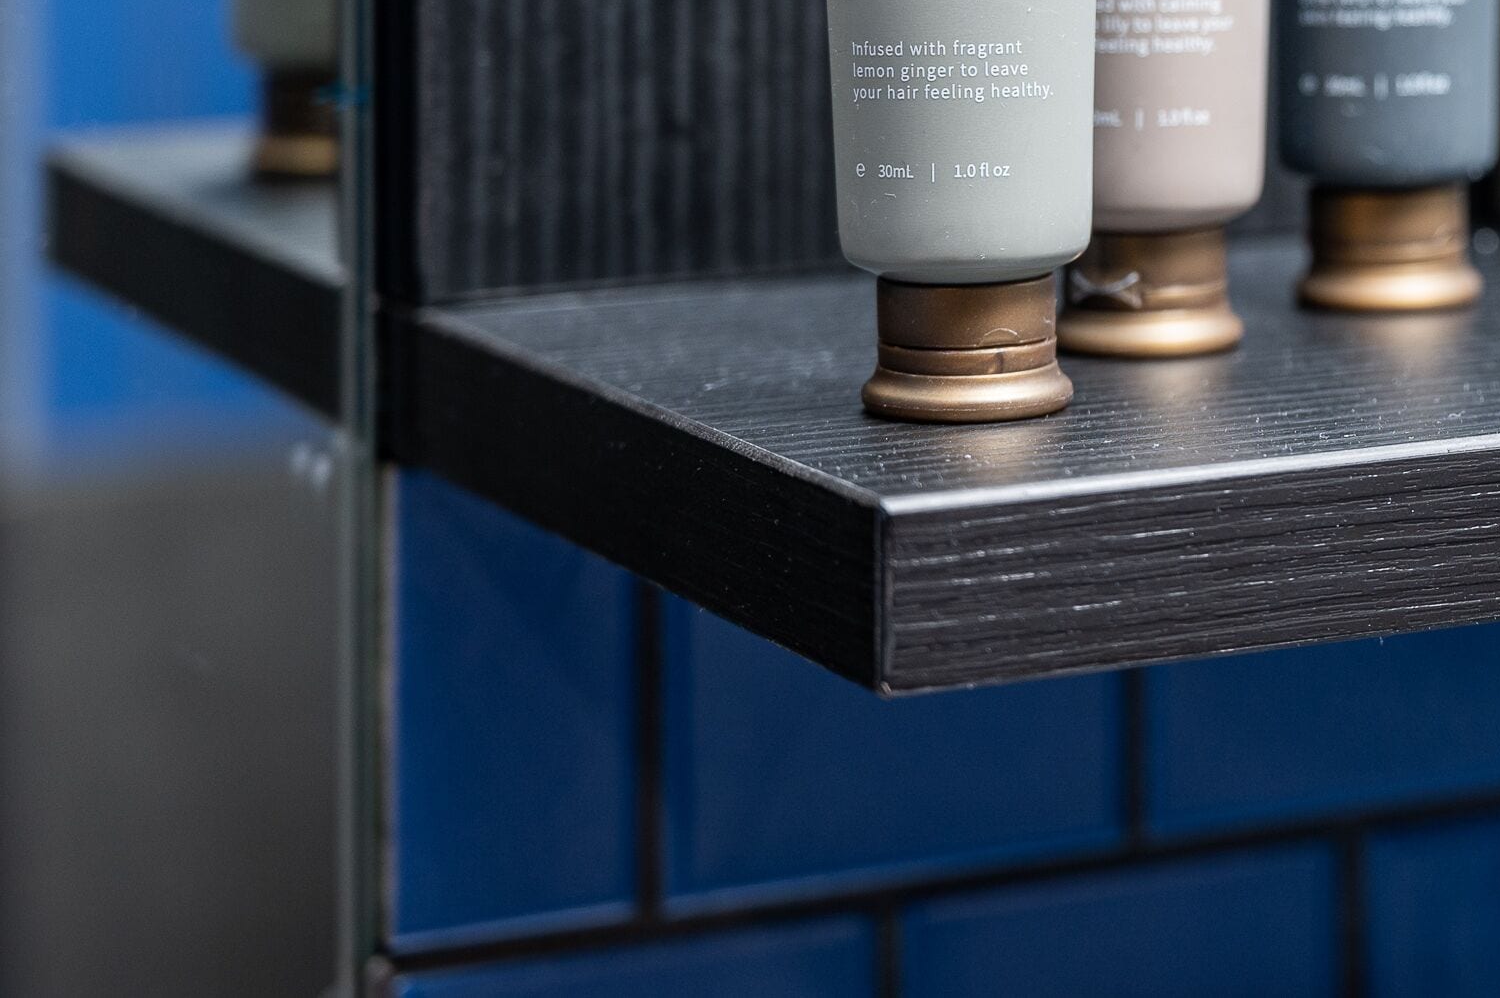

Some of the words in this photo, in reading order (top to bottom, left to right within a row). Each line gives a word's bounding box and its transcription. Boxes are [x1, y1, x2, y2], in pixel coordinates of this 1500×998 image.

[852, 41, 904, 57] Infused
[909, 40, 947, 56] with
[952, 39, 1023, 59] fragrant
[852, 62, 894, 78] lemon
[900, 64, 954, 81] ginger
[959, 62, 979, 77] to
[985, 61, 1029, 77] leave
[852, 88, 882, 102] your
[887, 85, 919, 100] hair
[924, 83, 985, 102] feeling
[991, 81, 1054, 99] healthy.
[877, 164, 914, 179] 30mL
[954, 164, 977, 178] 1.0
[979, 162, 990, 178] fl
[993, 164, 1011, 178] oz
